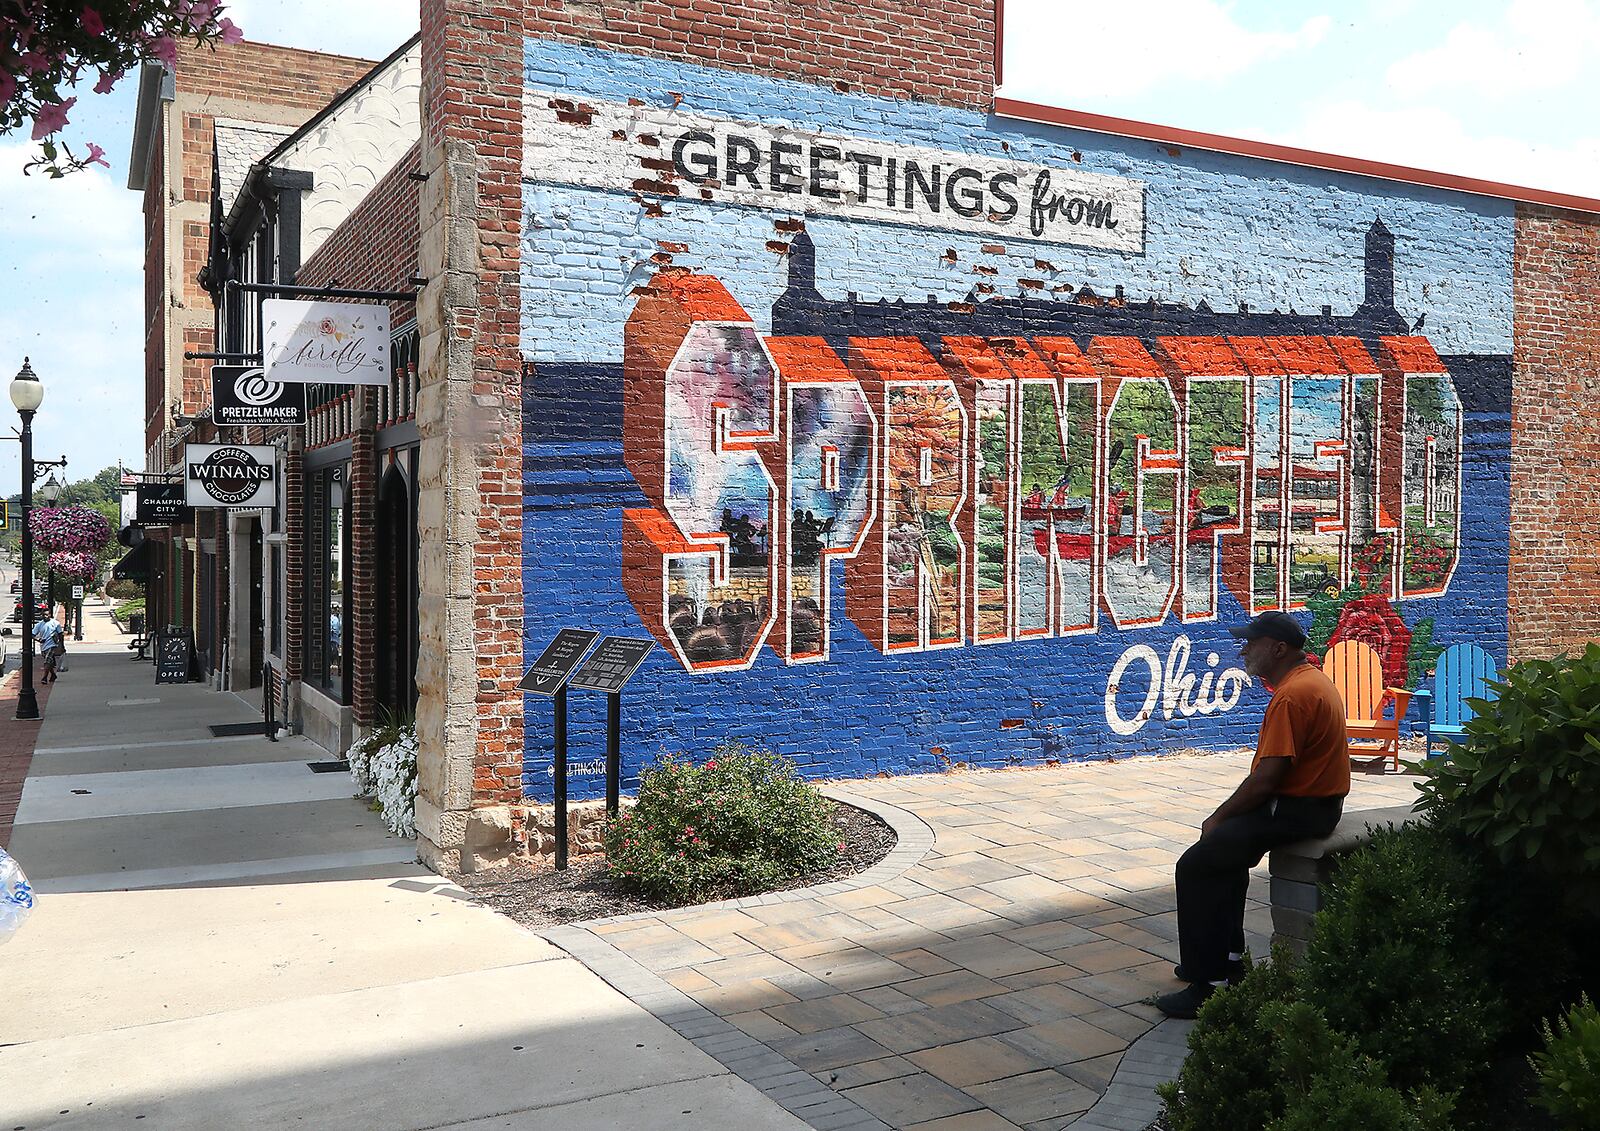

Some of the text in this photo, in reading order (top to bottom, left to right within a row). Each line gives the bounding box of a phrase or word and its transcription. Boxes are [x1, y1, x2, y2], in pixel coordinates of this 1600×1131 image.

[671, 130, 1119, 237] GREETINGS from
[280, 337, 368, 374] firefly
[222, 406, 298, 418] PRETZELMAKER
[212, 449, 250, 461] COFFEES
[193, 464, 270, 479] WINANS
[622, 269, 1465, 676] SPRINGFIELD
[205, 482, 257, 502] CHOCOLATES
[1105, 634, 1253, 736] Ohio
